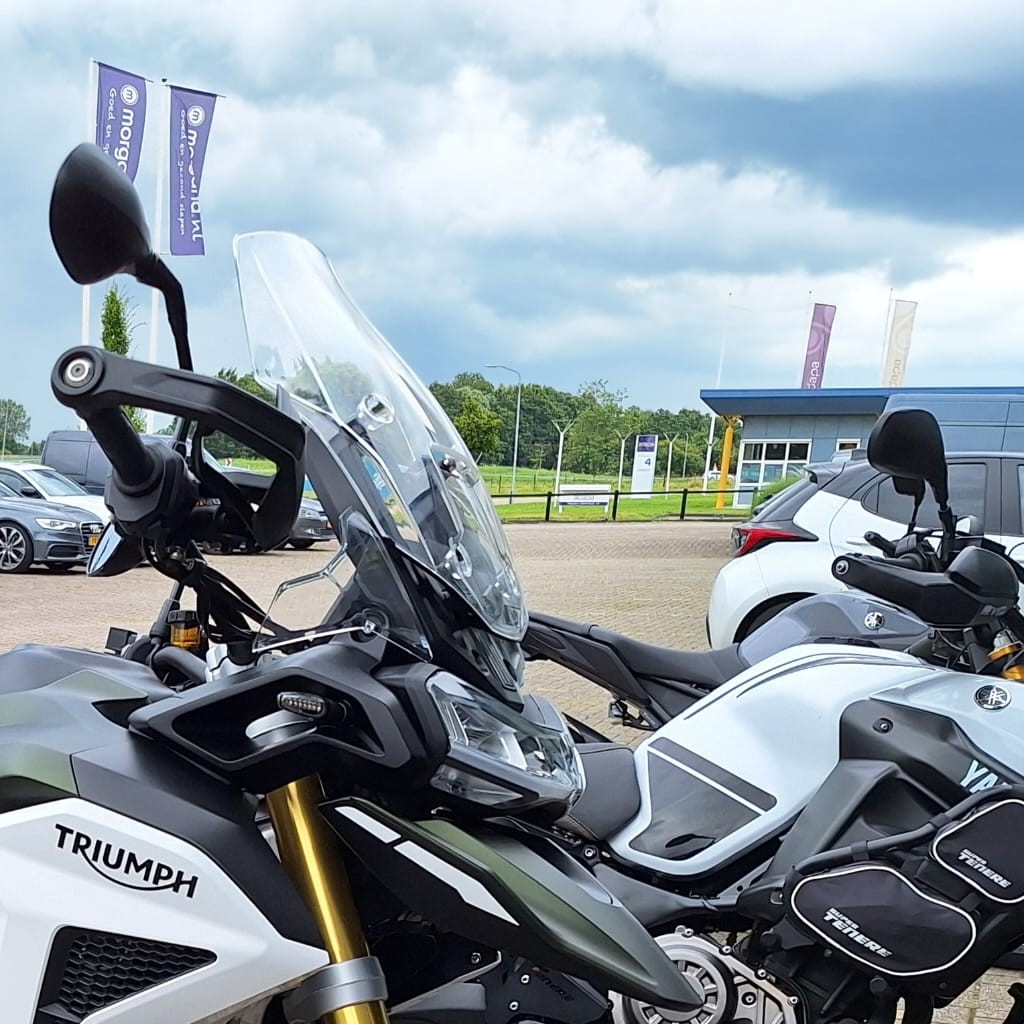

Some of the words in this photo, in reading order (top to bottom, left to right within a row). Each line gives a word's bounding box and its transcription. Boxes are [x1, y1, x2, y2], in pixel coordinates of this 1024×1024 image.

[107, 87, 117, 120] Goed
[644, 458, 652, 466] 4
[960, 759, 1008, 793] YA
[55, 823, 199, 898] TRIUMPH
[823, 911, 893, 957] TENERE
